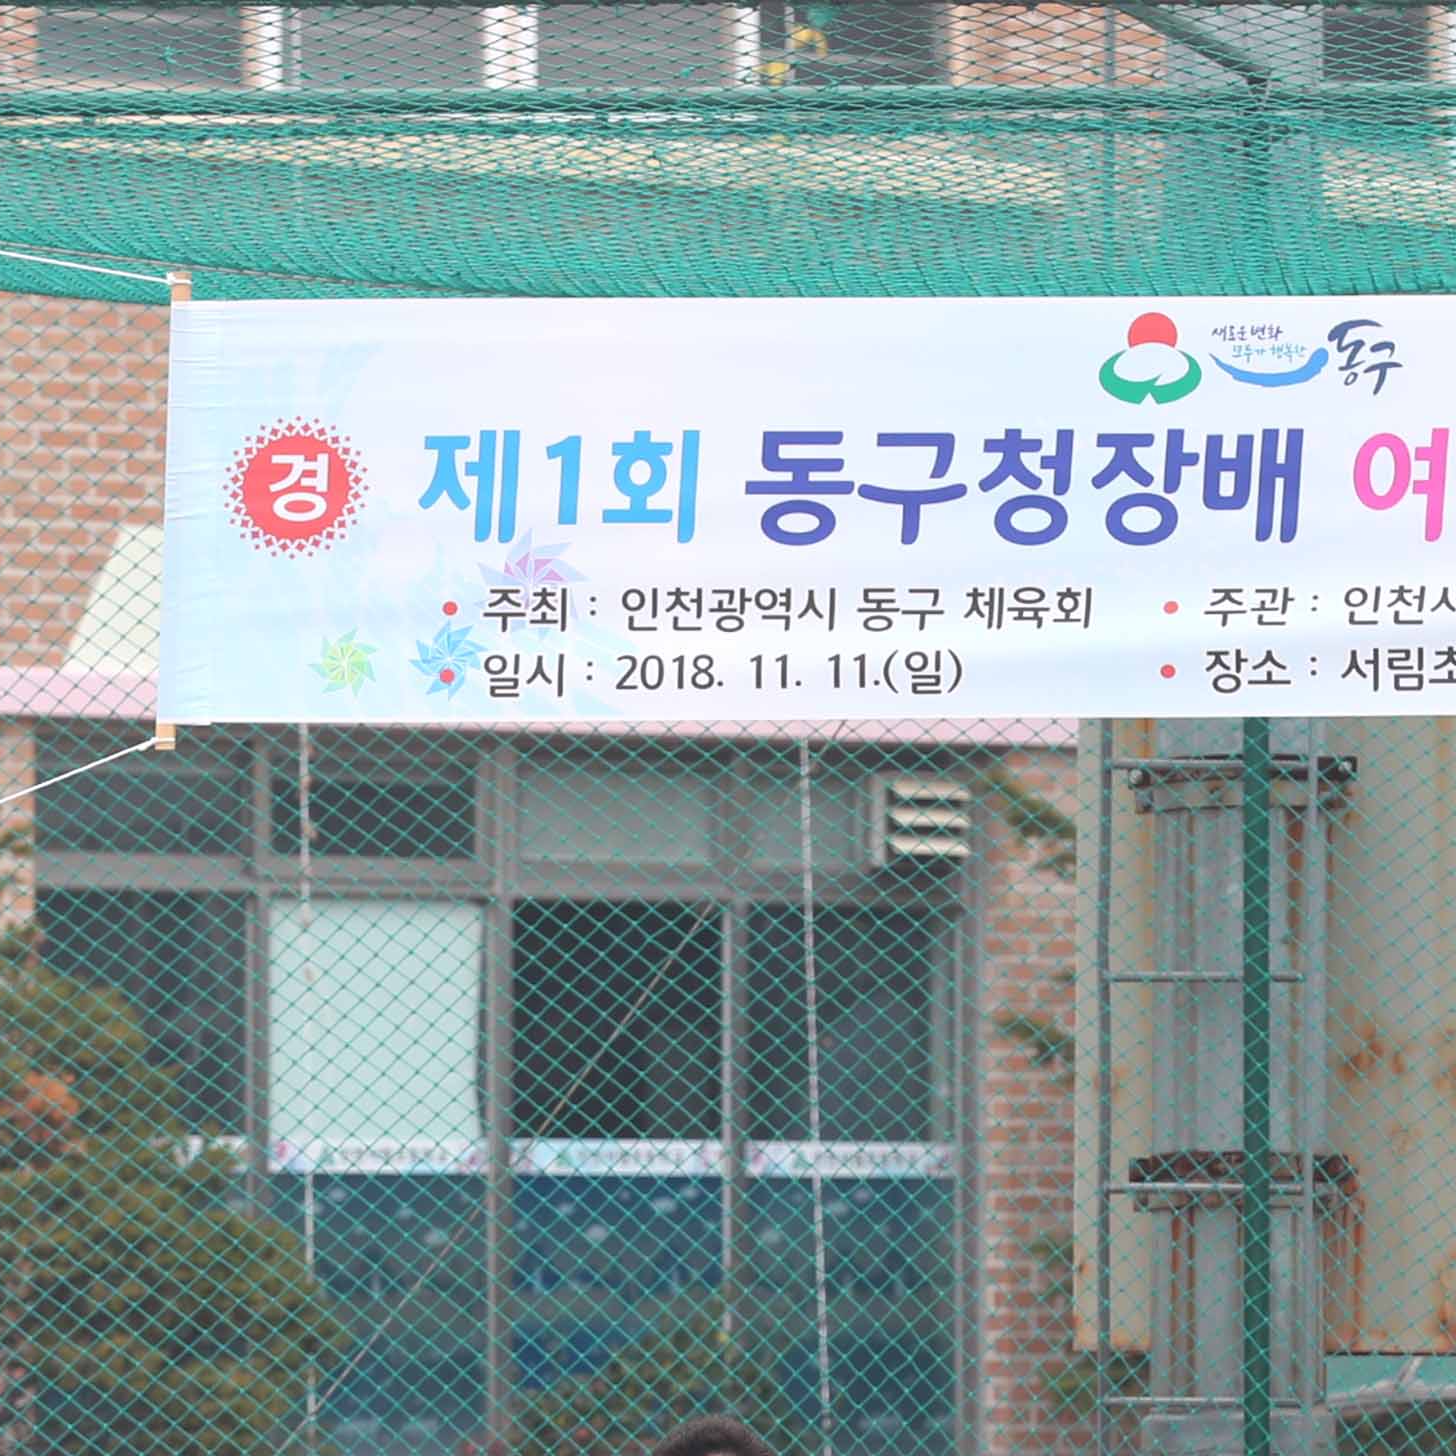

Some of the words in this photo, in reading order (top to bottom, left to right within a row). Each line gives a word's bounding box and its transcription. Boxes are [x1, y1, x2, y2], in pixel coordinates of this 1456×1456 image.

[1250, 323, 1284, 342] 변화
[1327, 318, 1403, 396] 동구
[268, 452, 330, 523] 경
[417, 428, 701, 545] 제1회
[743, 427, 1306, 548] 동구청장배
[483, 587, 567, 633] 주최
[622, 587, 836, 633] 인천광역시
[857, 588, 944, 632] 동구
[964, 587, 1093, 630] 체육회
[1204, 587, 1295, 628] 주관
[483, 654, 565, 698] 일시
[616, 654, 724, 690] 2018.
[1205, 649, 1292, 694] 장소
